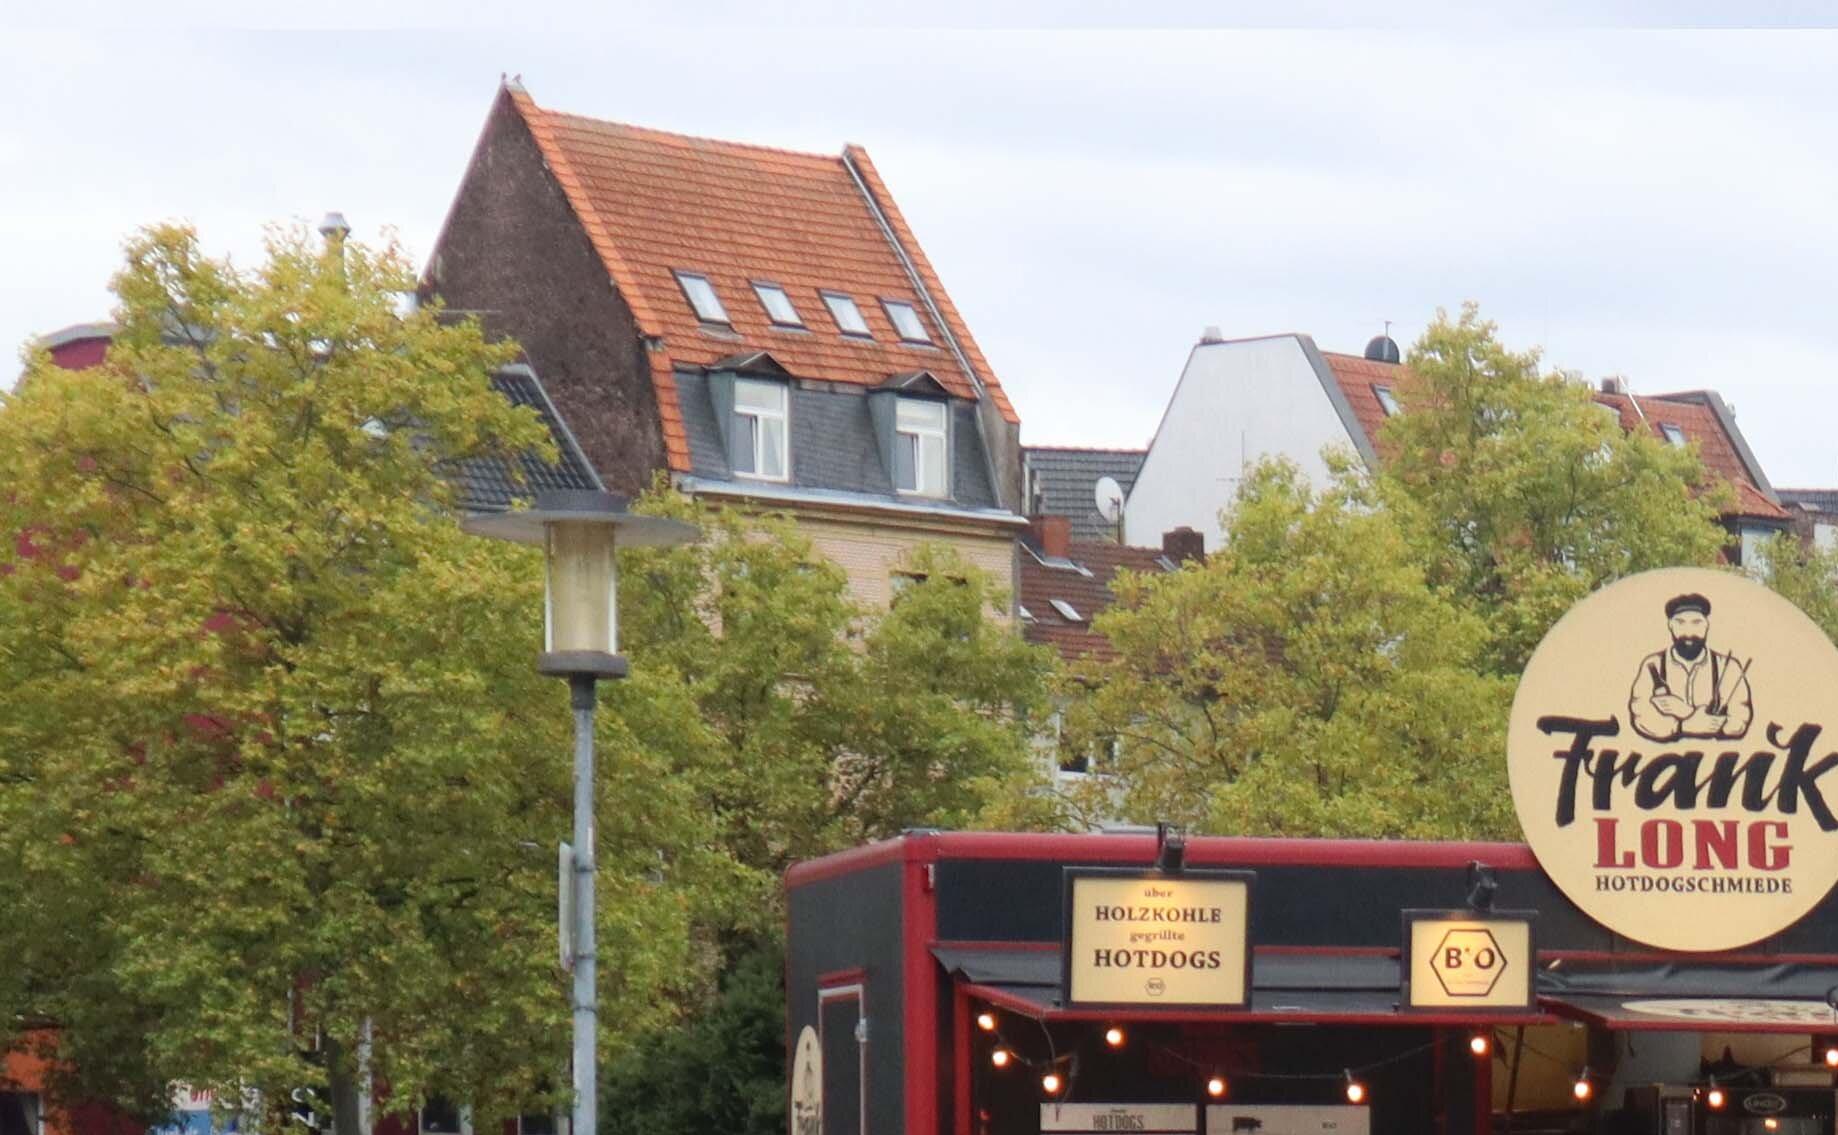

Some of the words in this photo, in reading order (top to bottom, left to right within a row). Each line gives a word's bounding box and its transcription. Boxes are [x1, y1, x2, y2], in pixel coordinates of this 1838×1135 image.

[1593, 817, 1793, 871] LONG
[1144, 888, 1173, 897] über
[1595, 875, 1793, 895] HOTDOGSCHMIEDE
[1095, 905, 1222, 923] HOLZKOHLE
[1129, 930, 1185, 943] gegrillte
[1093, 948, 1221, 969] HOTDOGS
[1445, 947, 1495, 969] BO
